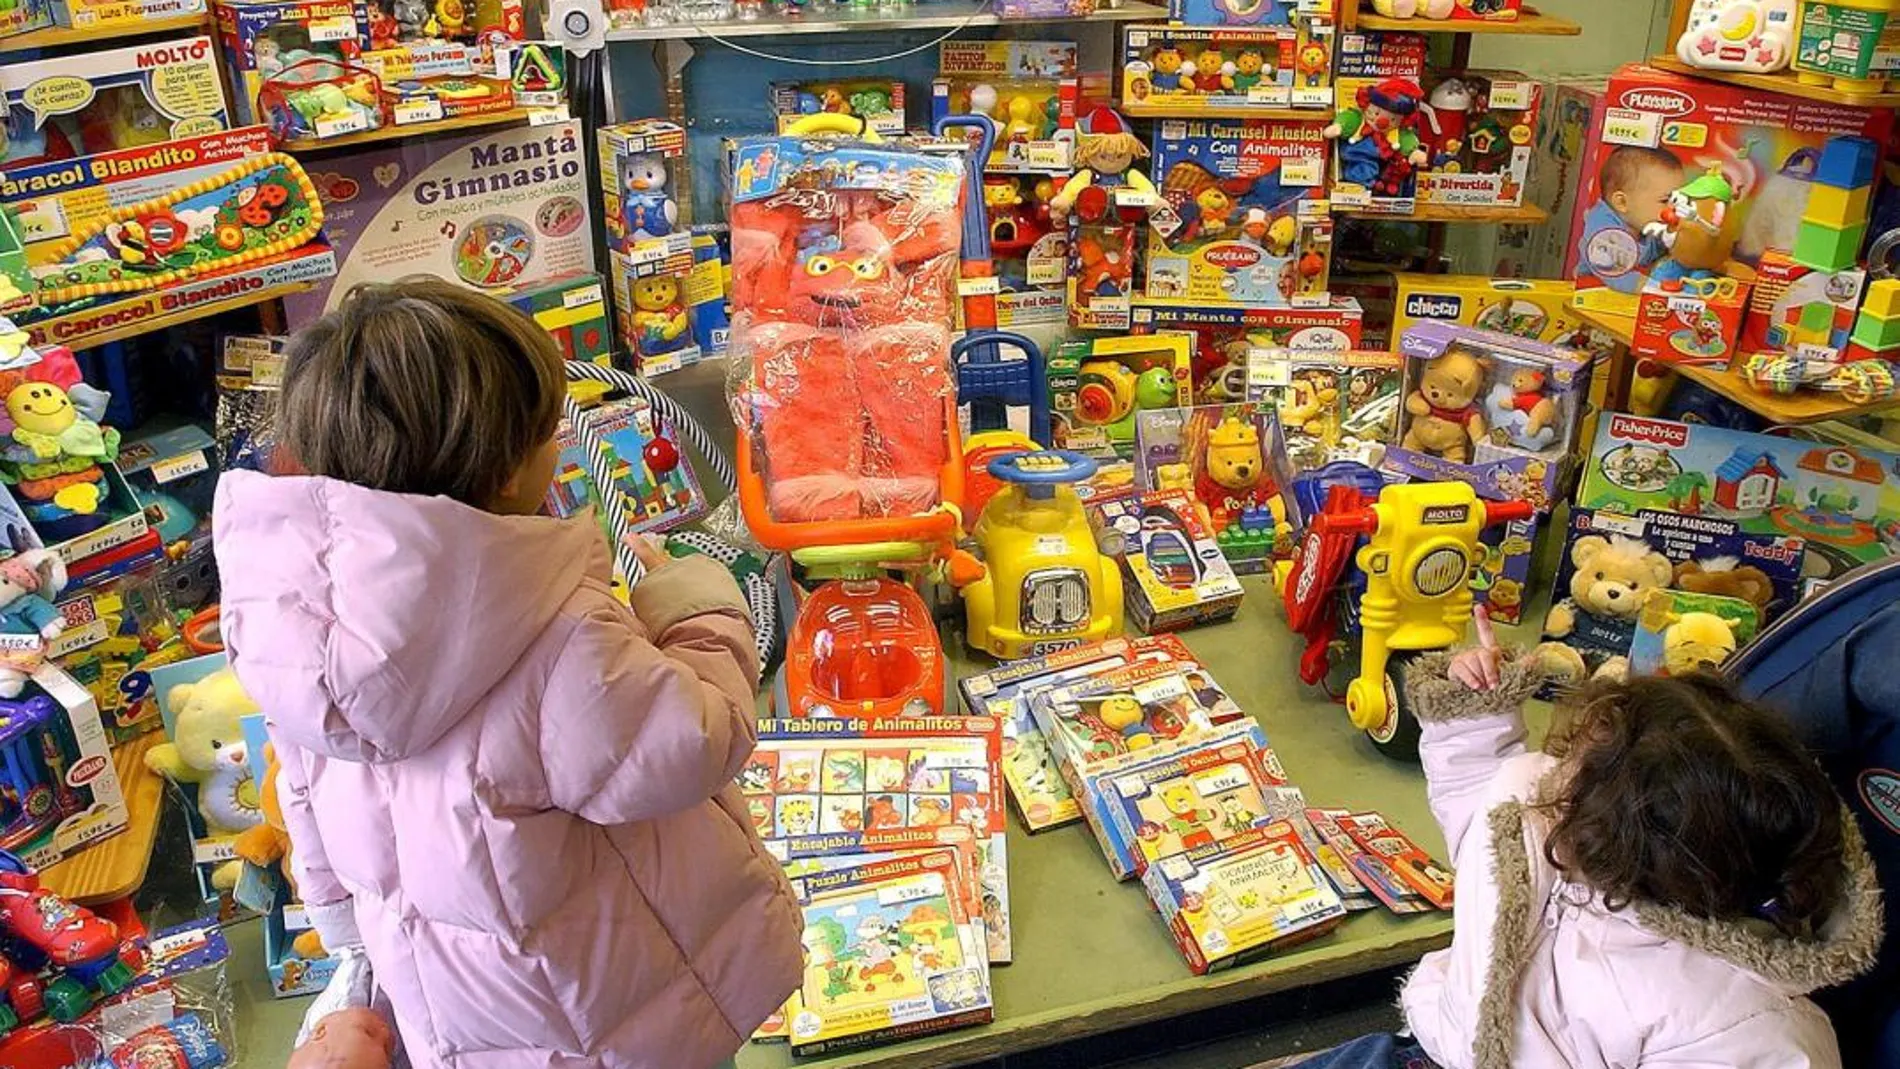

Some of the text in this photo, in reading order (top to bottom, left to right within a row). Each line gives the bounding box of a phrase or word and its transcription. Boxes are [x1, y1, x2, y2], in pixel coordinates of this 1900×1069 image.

[137, 44, 205, 68] MOLTO
[1665, 125, 1679, 141] 2
[470, 132, 577, 170] Manta
[1210, 140, 1322, 158] Con Animalitos
[0, 149, 197, 198] aracol Blandito
[413, 156, 580, 205] Gimnasio
[53, 300, 155, 339] Caracol
[161, 276, 264, 310] Blandito
[1155, 310, 1177, 321] Mi
[1183, 311, 1236, 323] Manta
[1240, 314, 1269, 325] con
[1407, 297, 1458, 317] chicco
[1613, 419, 1686, 442] Fisher-Price
[1427, 509, 1463, 519] MOLTO
[1639, 511, 1736, 535] LOS OSOS MARCHOSOS
[1744, 541, 1796, 565] Teddy
[758, 716, 963, 733] Mi Tablero de Animalitos
[860, 830, 934, 846] Animalitos
[808, 861, 920, 889] Puzzle Animalitos
